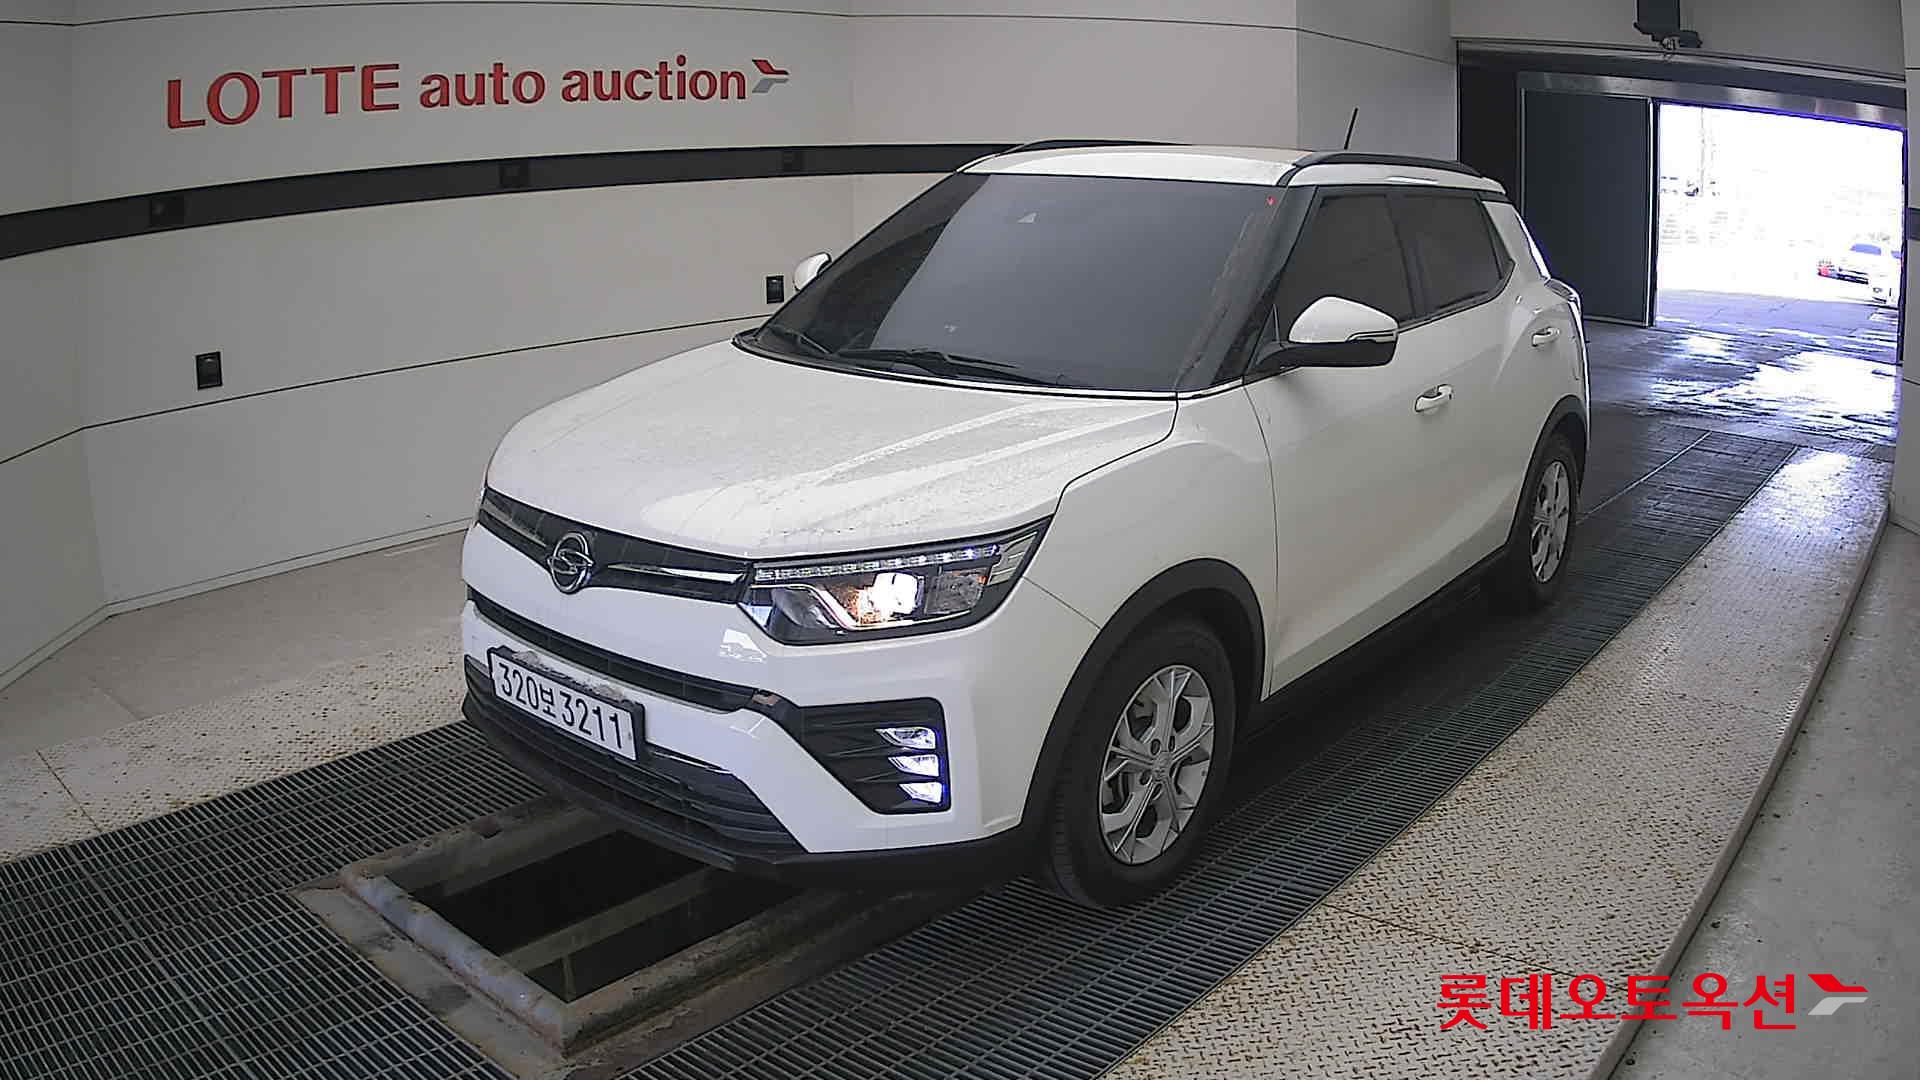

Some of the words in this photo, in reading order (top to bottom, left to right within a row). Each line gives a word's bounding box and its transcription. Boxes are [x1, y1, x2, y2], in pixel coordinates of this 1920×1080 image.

[167, 64, 400, 129] LOTTE
[420, 62, 546, 108] auto
[562, 55, 747, 103] auction
